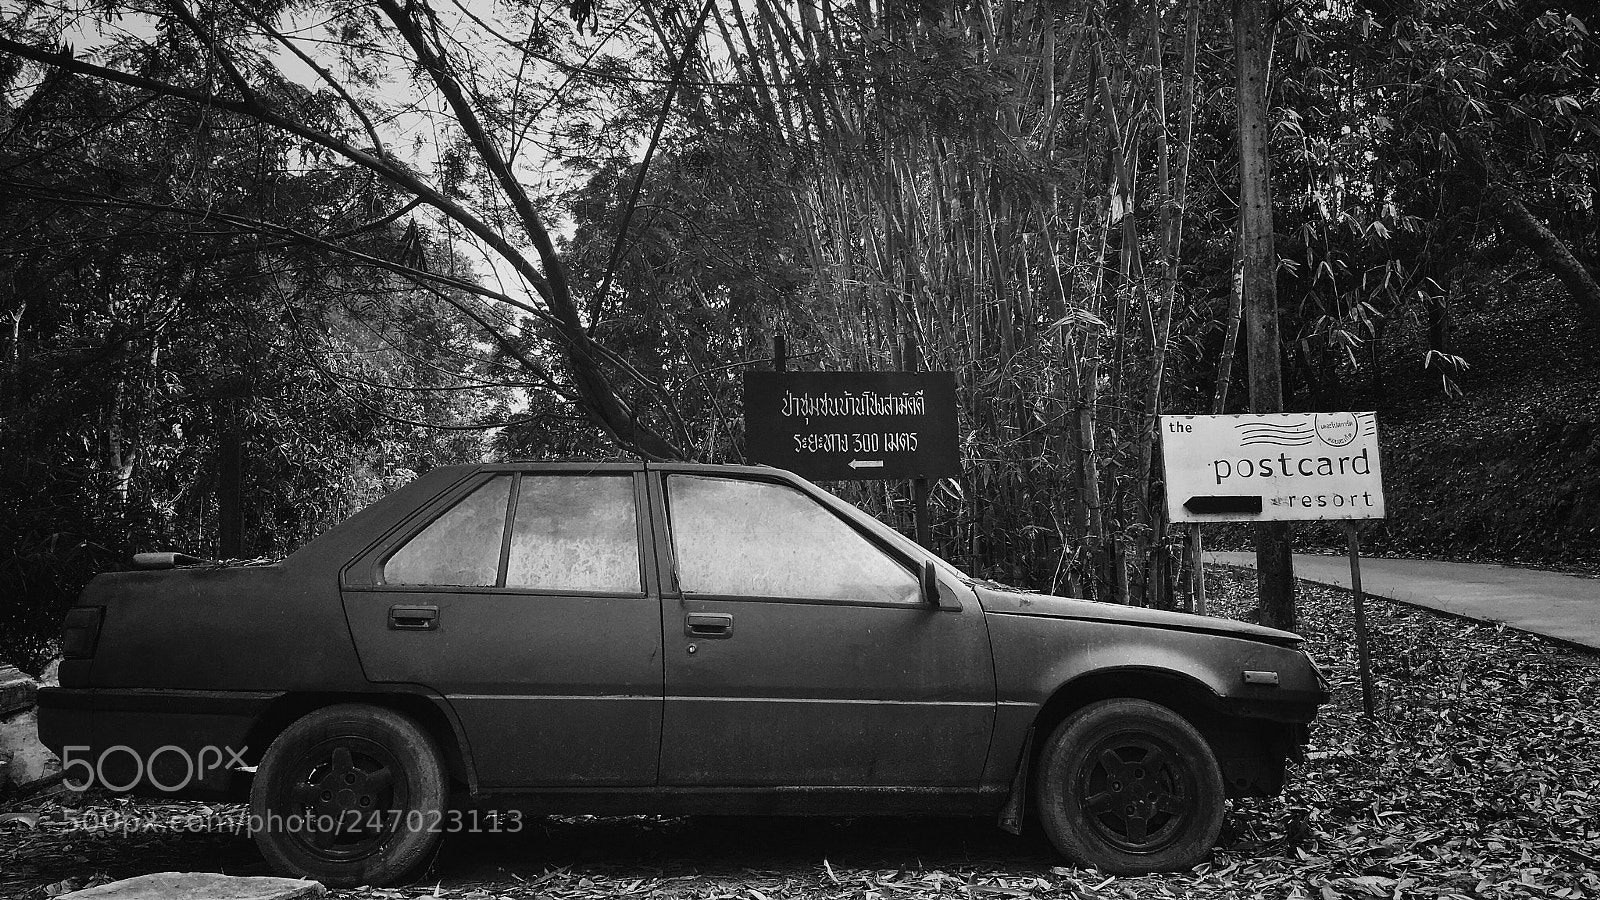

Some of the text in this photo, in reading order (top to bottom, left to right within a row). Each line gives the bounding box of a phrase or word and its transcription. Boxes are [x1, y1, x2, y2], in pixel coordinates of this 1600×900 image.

[1168, 421, 1193, 433] the
[793, 432, 918, 453] ระยะทาง 300 เมตร
[1213, 447, 1371, 485] postcard
[1287, 491, 1374, 508] resort
